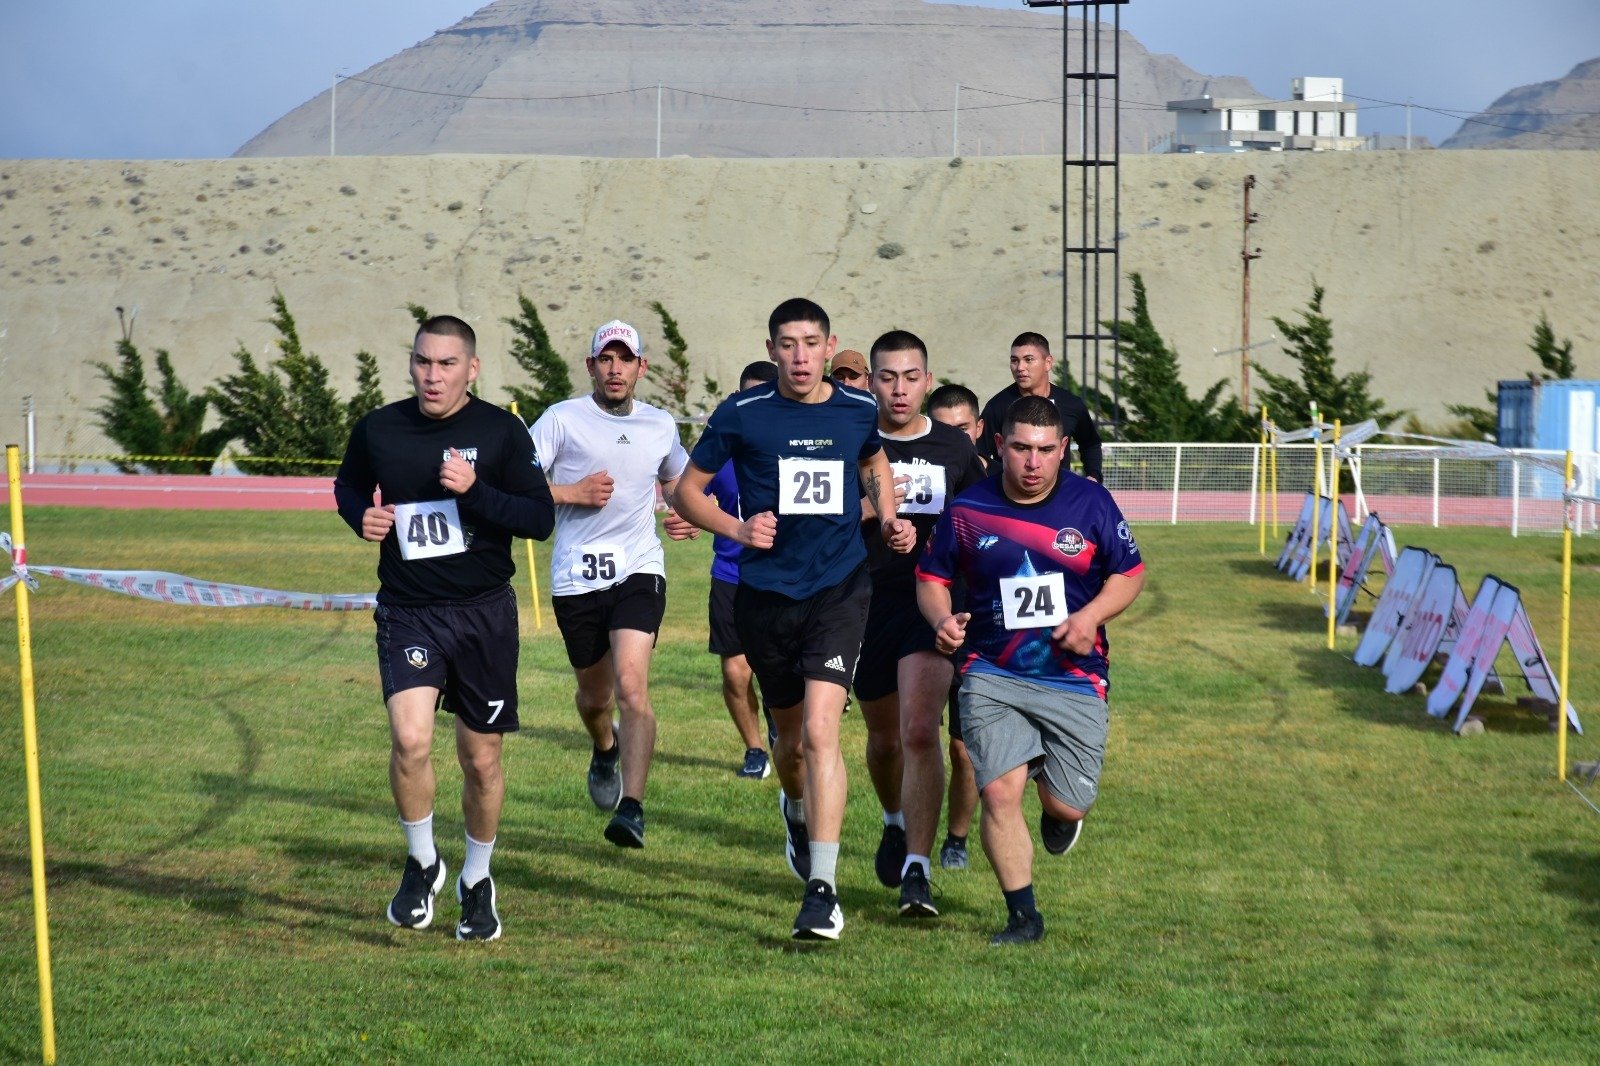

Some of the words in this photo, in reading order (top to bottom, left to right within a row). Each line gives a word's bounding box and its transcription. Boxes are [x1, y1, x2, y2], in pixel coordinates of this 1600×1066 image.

[599, 328, 632, 341] MUEVE
[793, 470, 831, 504] 25
[903, 474, 933, 505] 23
[407, 511, 450, 548] 40
[582, 552, 616, 581] 35
[1014, 585, 1056, 618] 24
[824, 661, 846, 673] adidas
[486, 699, 505, 724] 7
